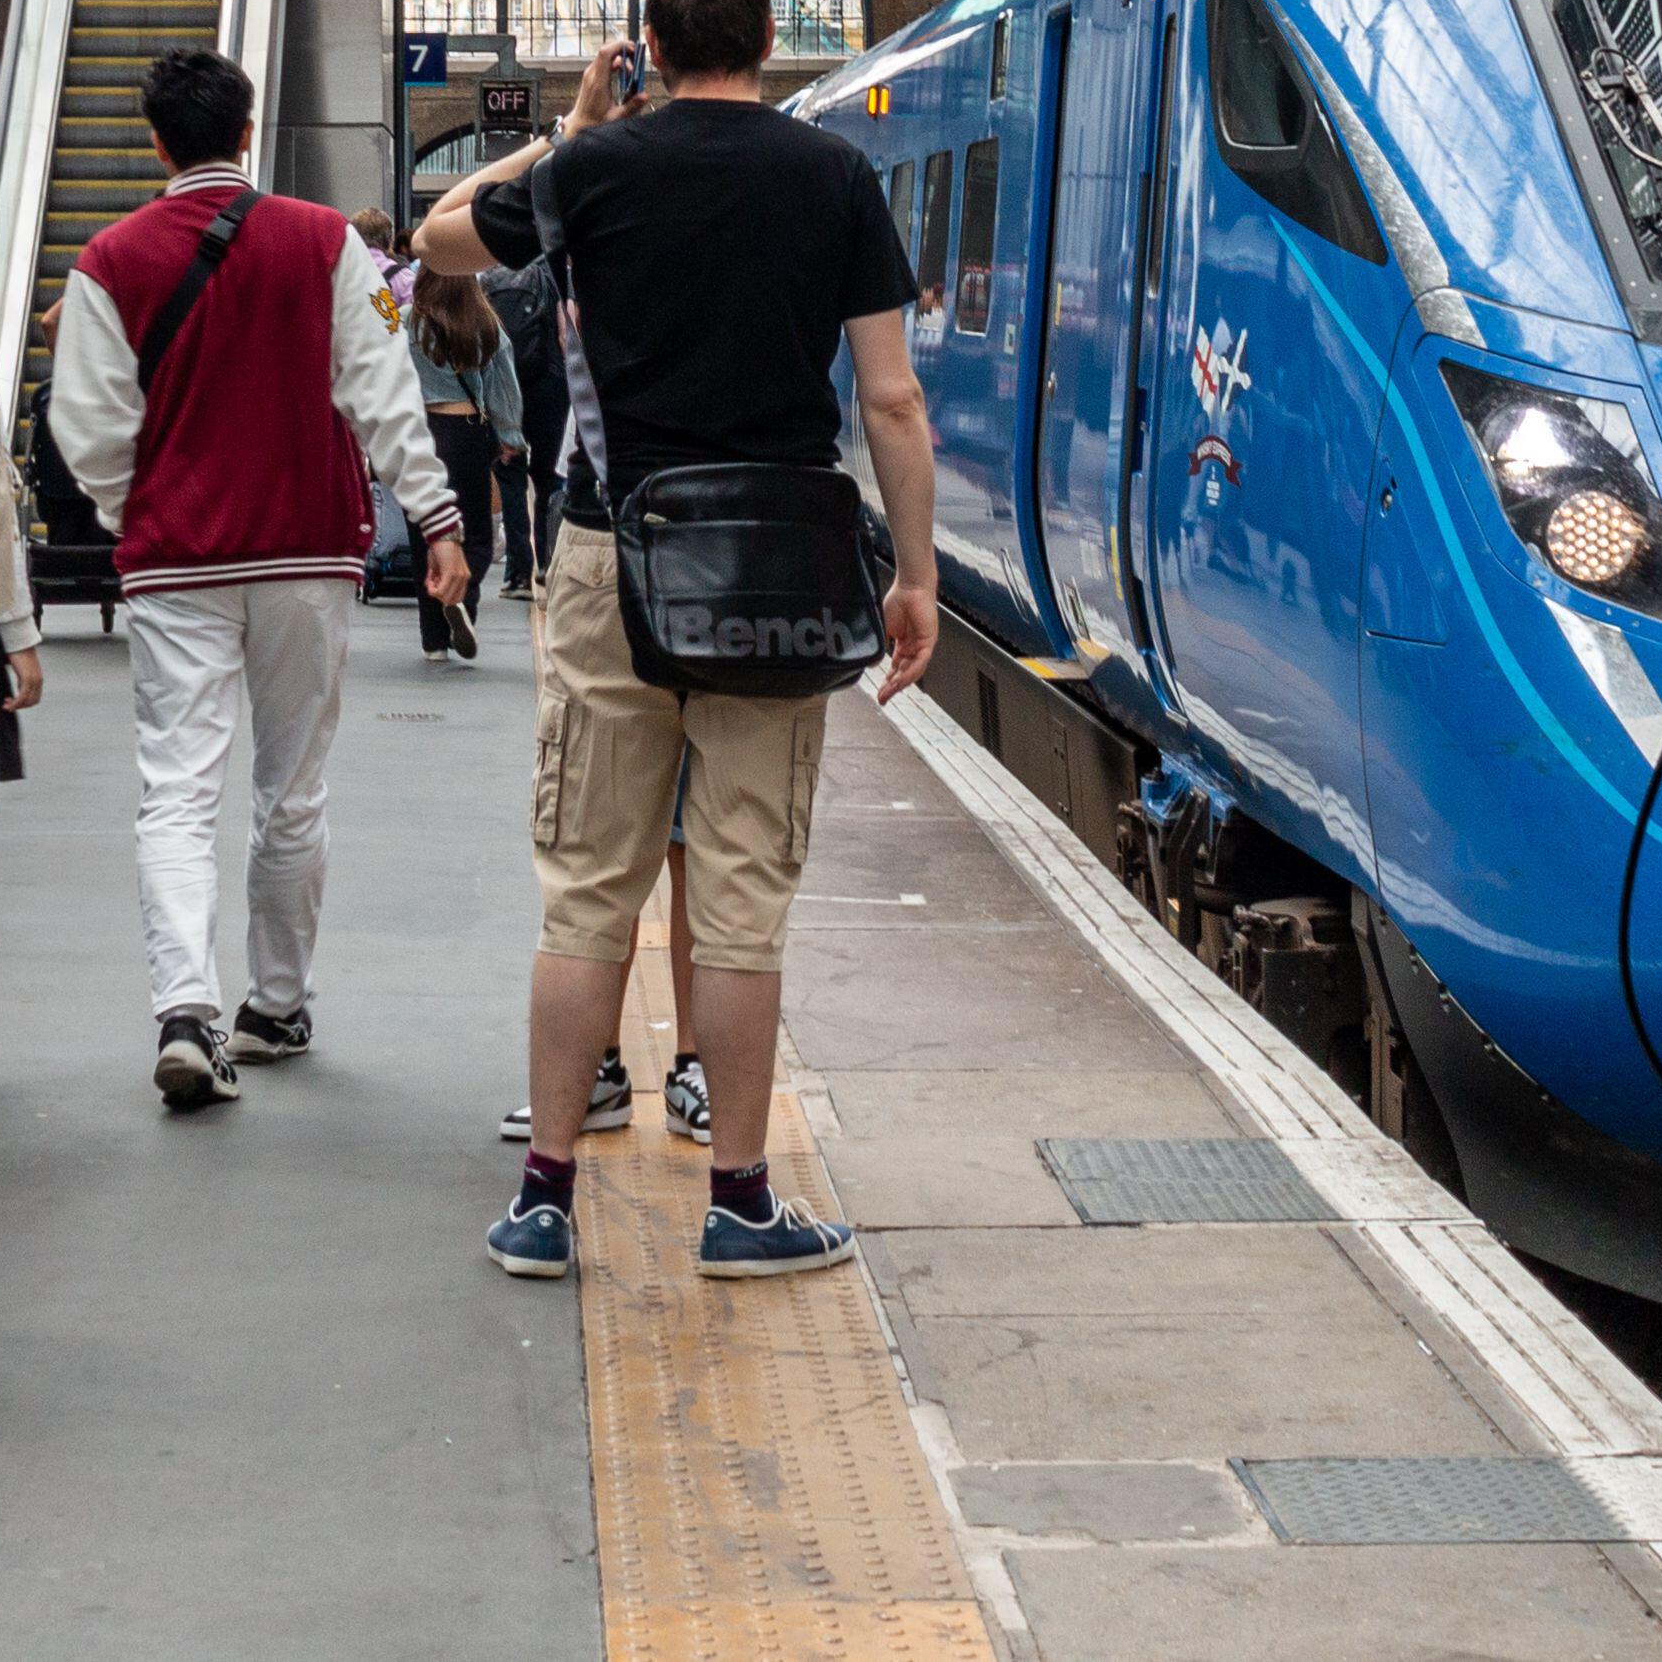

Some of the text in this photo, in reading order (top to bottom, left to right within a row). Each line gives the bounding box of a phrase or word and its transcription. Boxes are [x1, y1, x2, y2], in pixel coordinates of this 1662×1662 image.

[408, 44, 429, 73] 7
[486, 89, 526, 111] OFF
[666, 604, 855, 659] Bench
